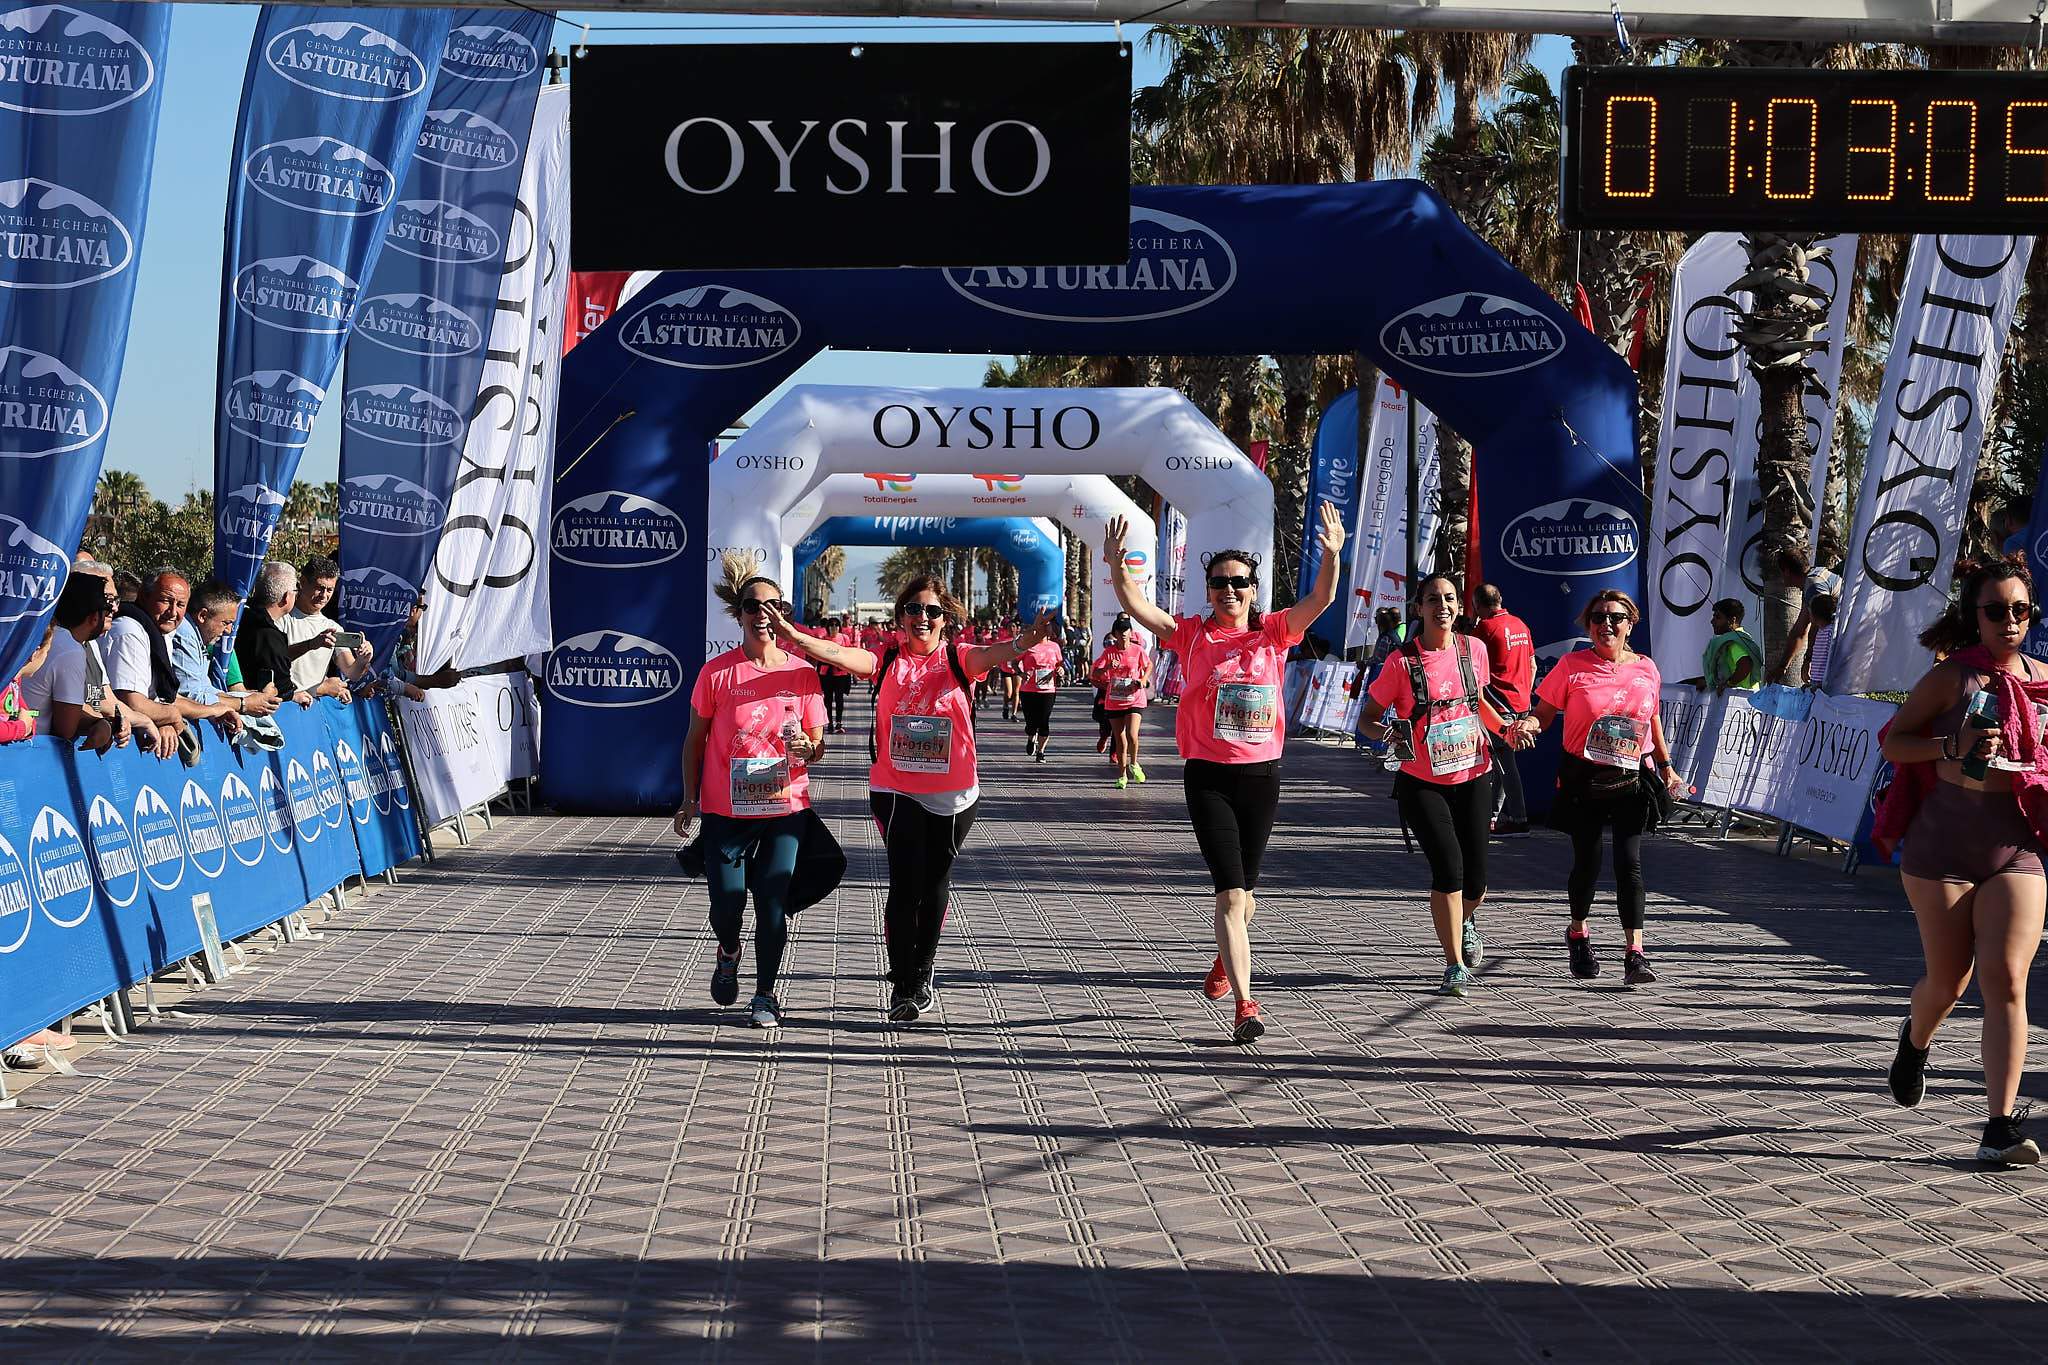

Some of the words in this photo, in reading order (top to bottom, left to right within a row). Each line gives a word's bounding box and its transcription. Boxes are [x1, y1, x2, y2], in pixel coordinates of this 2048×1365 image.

[0, 39, 60, 53] CENTRAL
[68, 44, 130, 58] LECHERA
[306, 40, 357, 57] CENTRAL
[361, 51, 411, 68] LECHERA
[0, 54, 134, 91] STURIANA
[276, 38, 411, 90] ASTURIANA
[418, 131, 507, 163] STURIANA
[425, 123, 462, 136] CENTRAL
[467, 131, 506, 145] LECHERA
[283, 156, 329, 171] CENTRAL
[334, 165, 383, 182] LECHERA
[664, 117, 1051, 197] OYSHO
[255, 155, 383, 205] ASTURIANA
[0, 215, 35, 227] NTRAL
[43, 218, 108, 234] LECHERA
[402, 214, 442, 227] CENTRAL
[446, 222, 488, 237] LECHERA
[0, 231, 112, 268] TURIANA
[1127, 238, 1205, 249] ECHERA
[261, 275, 304, 290] CENTRAL
[308, 283, 357, 301] LECHERA
[359, 306, 471, 348] ASTURIANA
[383, 308, 424, 321] CENTRAL
[428, 315, 470, 330] LECHERA
[629, 316, 786, 348] ASTURIANA
[660, 313, 718, 322] CENTRAL
[725, 314, 783, 324] LECHERA
[1420, 321, 1480, 332] CENTRAL
[1487, 319, 1545, 328] LECHERA
[1396, 327, 1556, 357] ASTURIANA
[28, 386, 86, 403] LECHERA
[345, 397, 454, 438] ASTURIANA
[367, 399, 407, 412] CENTRAL
[412, 406, 453, 420] LECHERA
[872, 404, 1101, 451] OYSHO
[736, 456, 804, 471] OYSHO
[1165, 456, 1233, 472] OYSHO
[1660, 295, 1748, 617] OYSHO
[352, 489, 392, 503] CENTRAL
[397, 495, 436, 509] LECHERA
[863, 496, 918, 505] TotalEnergies
[972, 496, 1026, 505] TotalEnergies
[554, 519, 678, 550] ASTURIANA
[571, 517, 619, 526] CENTRAL
[625, 518, 674, 528] LECHERA
[1532, 525, 1583, 534] CENTRAL
[1589, 522, 1631, 531] LECHERA
[1510, 528, 1635, 557] ASTURIANA
[567, 656, 614, 664] CENTRAL
[618, 657, 669, 666] LECHERA
[706, 640, 742, 654] OYS
[551, 657, 673, 689] ASTURIANA
[1725, 708, 1785, 760] OYSHO
[1799, 716, 1869, 781] OYSHO
[138, 828, 182, 868] ASTURIANA
[185, 818, 223, 855] ASTURIANA
[93, 839, 136, 882] ASTURIANA
[35, 857, 91, 903] ASTURIANA
